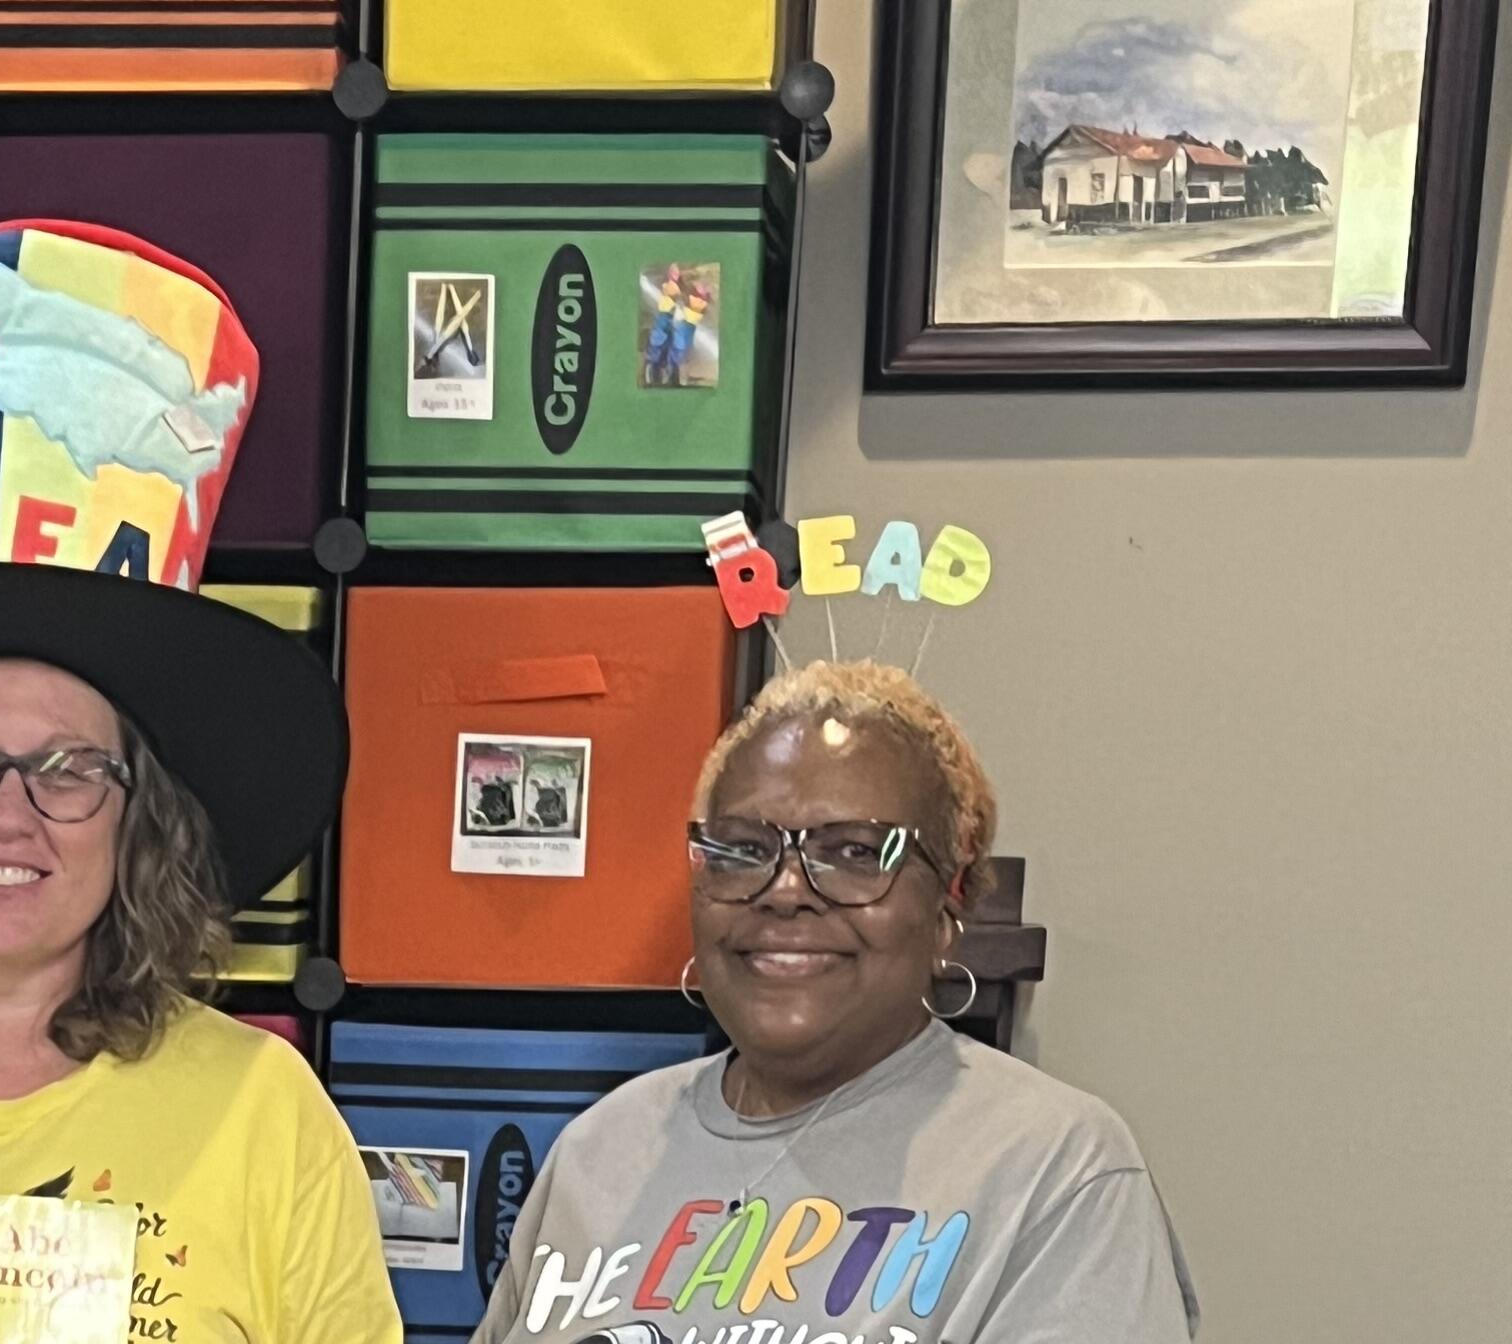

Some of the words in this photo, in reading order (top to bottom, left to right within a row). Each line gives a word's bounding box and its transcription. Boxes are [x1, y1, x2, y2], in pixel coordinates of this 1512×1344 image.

[544, 272, 585, 427] Crayon
[701, 510, 991, 629] READ
[526, 1242, 642, 1334] HE
[632, 1196, 971, 1318] EARTH
